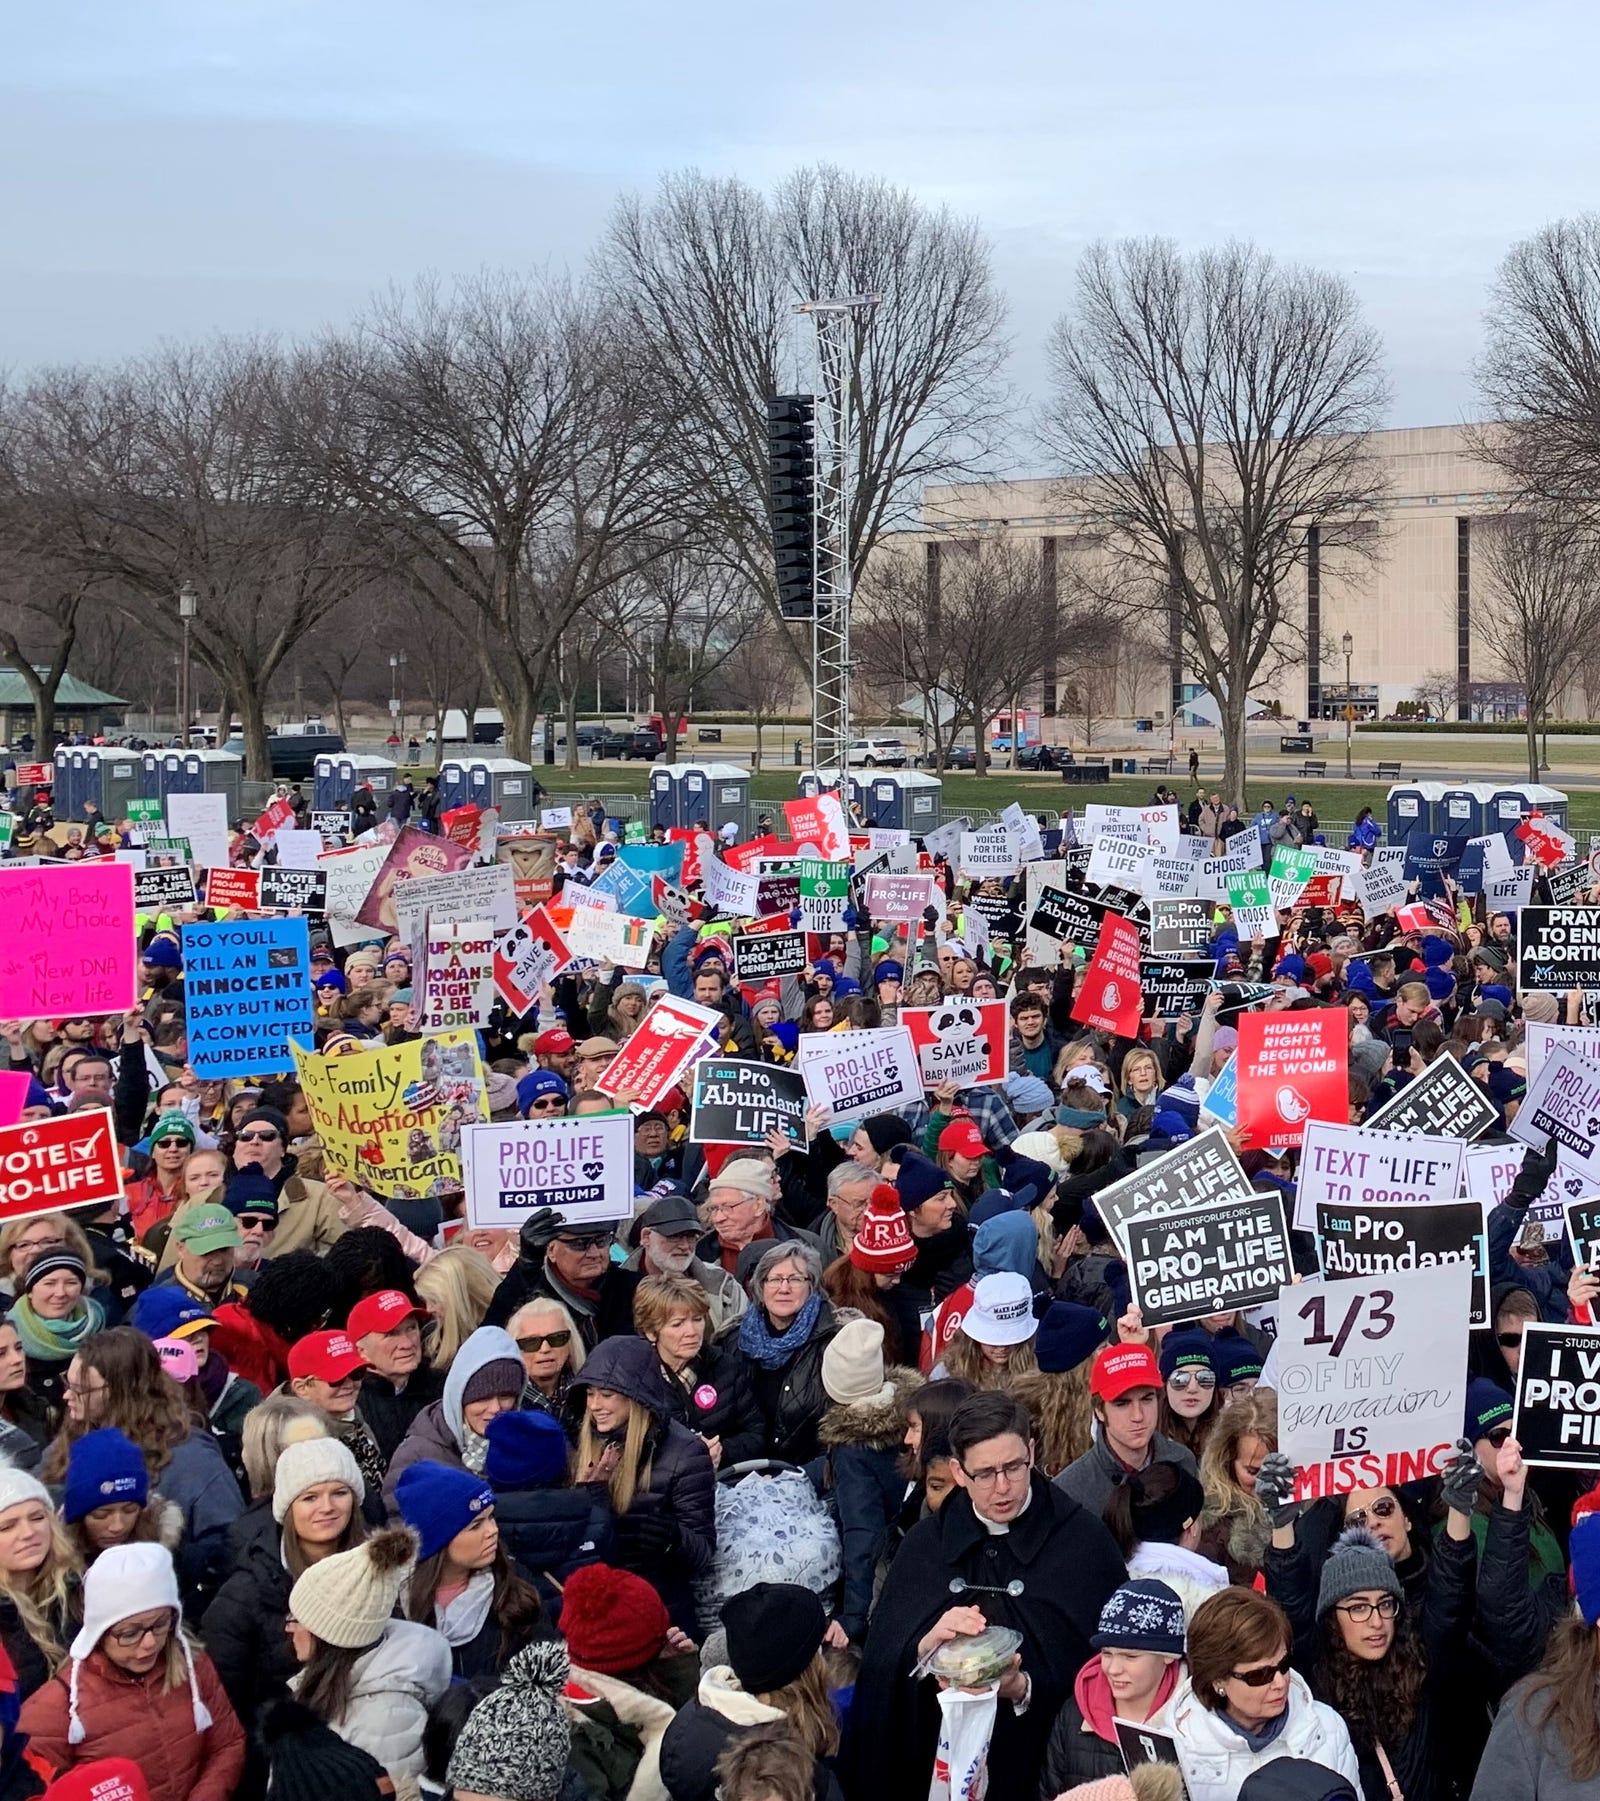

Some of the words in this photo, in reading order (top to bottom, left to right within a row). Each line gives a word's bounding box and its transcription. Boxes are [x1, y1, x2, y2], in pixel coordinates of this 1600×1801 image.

[792, 813, 815, 823] LOVE
[1105, 808, 1121, 817] LIFE
[793, 821, 819, 831] THEM
[795, 828, 821, 839] BOTH
[975, 835, 1006, 844] VOICES
[973, 845, 987, 854] FOR
[989, 844, 1008, 854] THE
[1323, 851, 1340, 861] CCU
[968, 854, 1013, 863] VOICELESS
[1107, 856, 1137, 873] LIFE
[802, 863, 824, 878] LOVE
[826, 863, 847, 878] LIFE
[1203, 859, 1247, 875] CHOOSE
[1361, 866, 1389, 880] VOICES
[213, 872, 235, 880] MOST
[270, 874, 275, 883] I
[281, 874, 317, 884] VOTE
[1156, 870, 1190, 883] BEATING
[1366, 880, 1378, 891] FOR
[1380, 875, 1397, 887] THE
[212, 880, 245, 889] PRO-LIFE
[262, 881, 325, 893] PRO-LIFE
[1159, 882, 1184, 893] HEART
[1365, 882, 1405, 903] VOICELESS
[1493, 883, 1518, 897] LIFE
[276, 893, 310, 904] FIRST
[803, 898, 842, 914] CHOOSE
[812, 915, 831, 931] LIFE
[1238, 908, 1269, 922] CHOOSE
[1549, 910, 1600, 926] PRAY
[185, 935, 212, 948] SO
[220, 932, 277, 945] YOULL
[1541, 927, 1566, 943] TO
[186, 958, 222, 971] KILL
[232, 954, 257, 968] AN
[738, 947, 805, 964] PRO-LIFE
[740, 959, 804, 974] GENERATION
[189, 972, 303, 996] INNOCENT
[429, 981, 478, 996] RIGHT
[191, 1003, 234, 1019] BABY
[240, 1000, 269, 1014] BUT
[275, 997, 309, 1012] NOT
[434, 999, 444, 1010] 2
[450, 996, 471, 1010] BE
[431, 1011, 479, 1027] BORN
[208, 1022, 313, 1039] CONVICTED
[1264, 1022, 1322, 1034] HUMAN
[1264, 1034, 1321, 1046] RIGHTS
[192, 1046, 291, 1065] MURDERER
[932, 1039, 976, 1060] SAVE
[1259, 1049, 1307, 1061] BEGIN
[1311, 1047, 1326, 1059] IN
[824, 1047, 897, 1082] PRO-LIFE
[1248, 1064, 1278, 1077] THE
[1283, 1060, 1337, 1074] WOMB
[828, 1071, 881, 1099] VOICES
[837, 1095, 860, 1111] FOR
[862, 1082, 900, 1104] TRUMP
[499, 1136, 604, 1166] PRO-LIFE
[1314, 1146, 1371, 1179] TEXT
[499, 1164, 576, 1189] VOICES
[1111, 1204, 1123, 1219] I
[1133, 1180, 1167, 1206] AM
[1174, 1147, 1223, 1178] THE
[505, 1194, 537, 1205] FOR
[546, 1187, 600, 1203] TRUMP
[1159, 1206, 1252, 1232] STUDENTSFORLIFE.ORG
[1323, 1212, 1329, 1230] I
[1331, 1218, 1352, 1232] am
[1354, 1215, 1404, 1240] Pro
[1581, 1212, 1590, 1230] I
[1141, 1237, 1151, 1256] I
[1163, 1227, 1207, 1251] AM
[1216, 1215, 1273, 1238] THE
[1136, 1234, 1284, 1287] PRO-LIFE
[1143, 1263, 1286, 1309] GENERATION
[1297, 1289, 1396, 1358] 1/3
[1550, 1350, 1560, 1378] I
[1279, 1362, 1336, 1394] OF
[1352, 1352, 1403, 1390] MY
[1282, 1387, 1452, 1433] generation
[1333, 1426, 1369, 1448] IS
[1292, 1442, 1459, 1501] MISSING
[90, 1777, 121, 1790] KEEP
